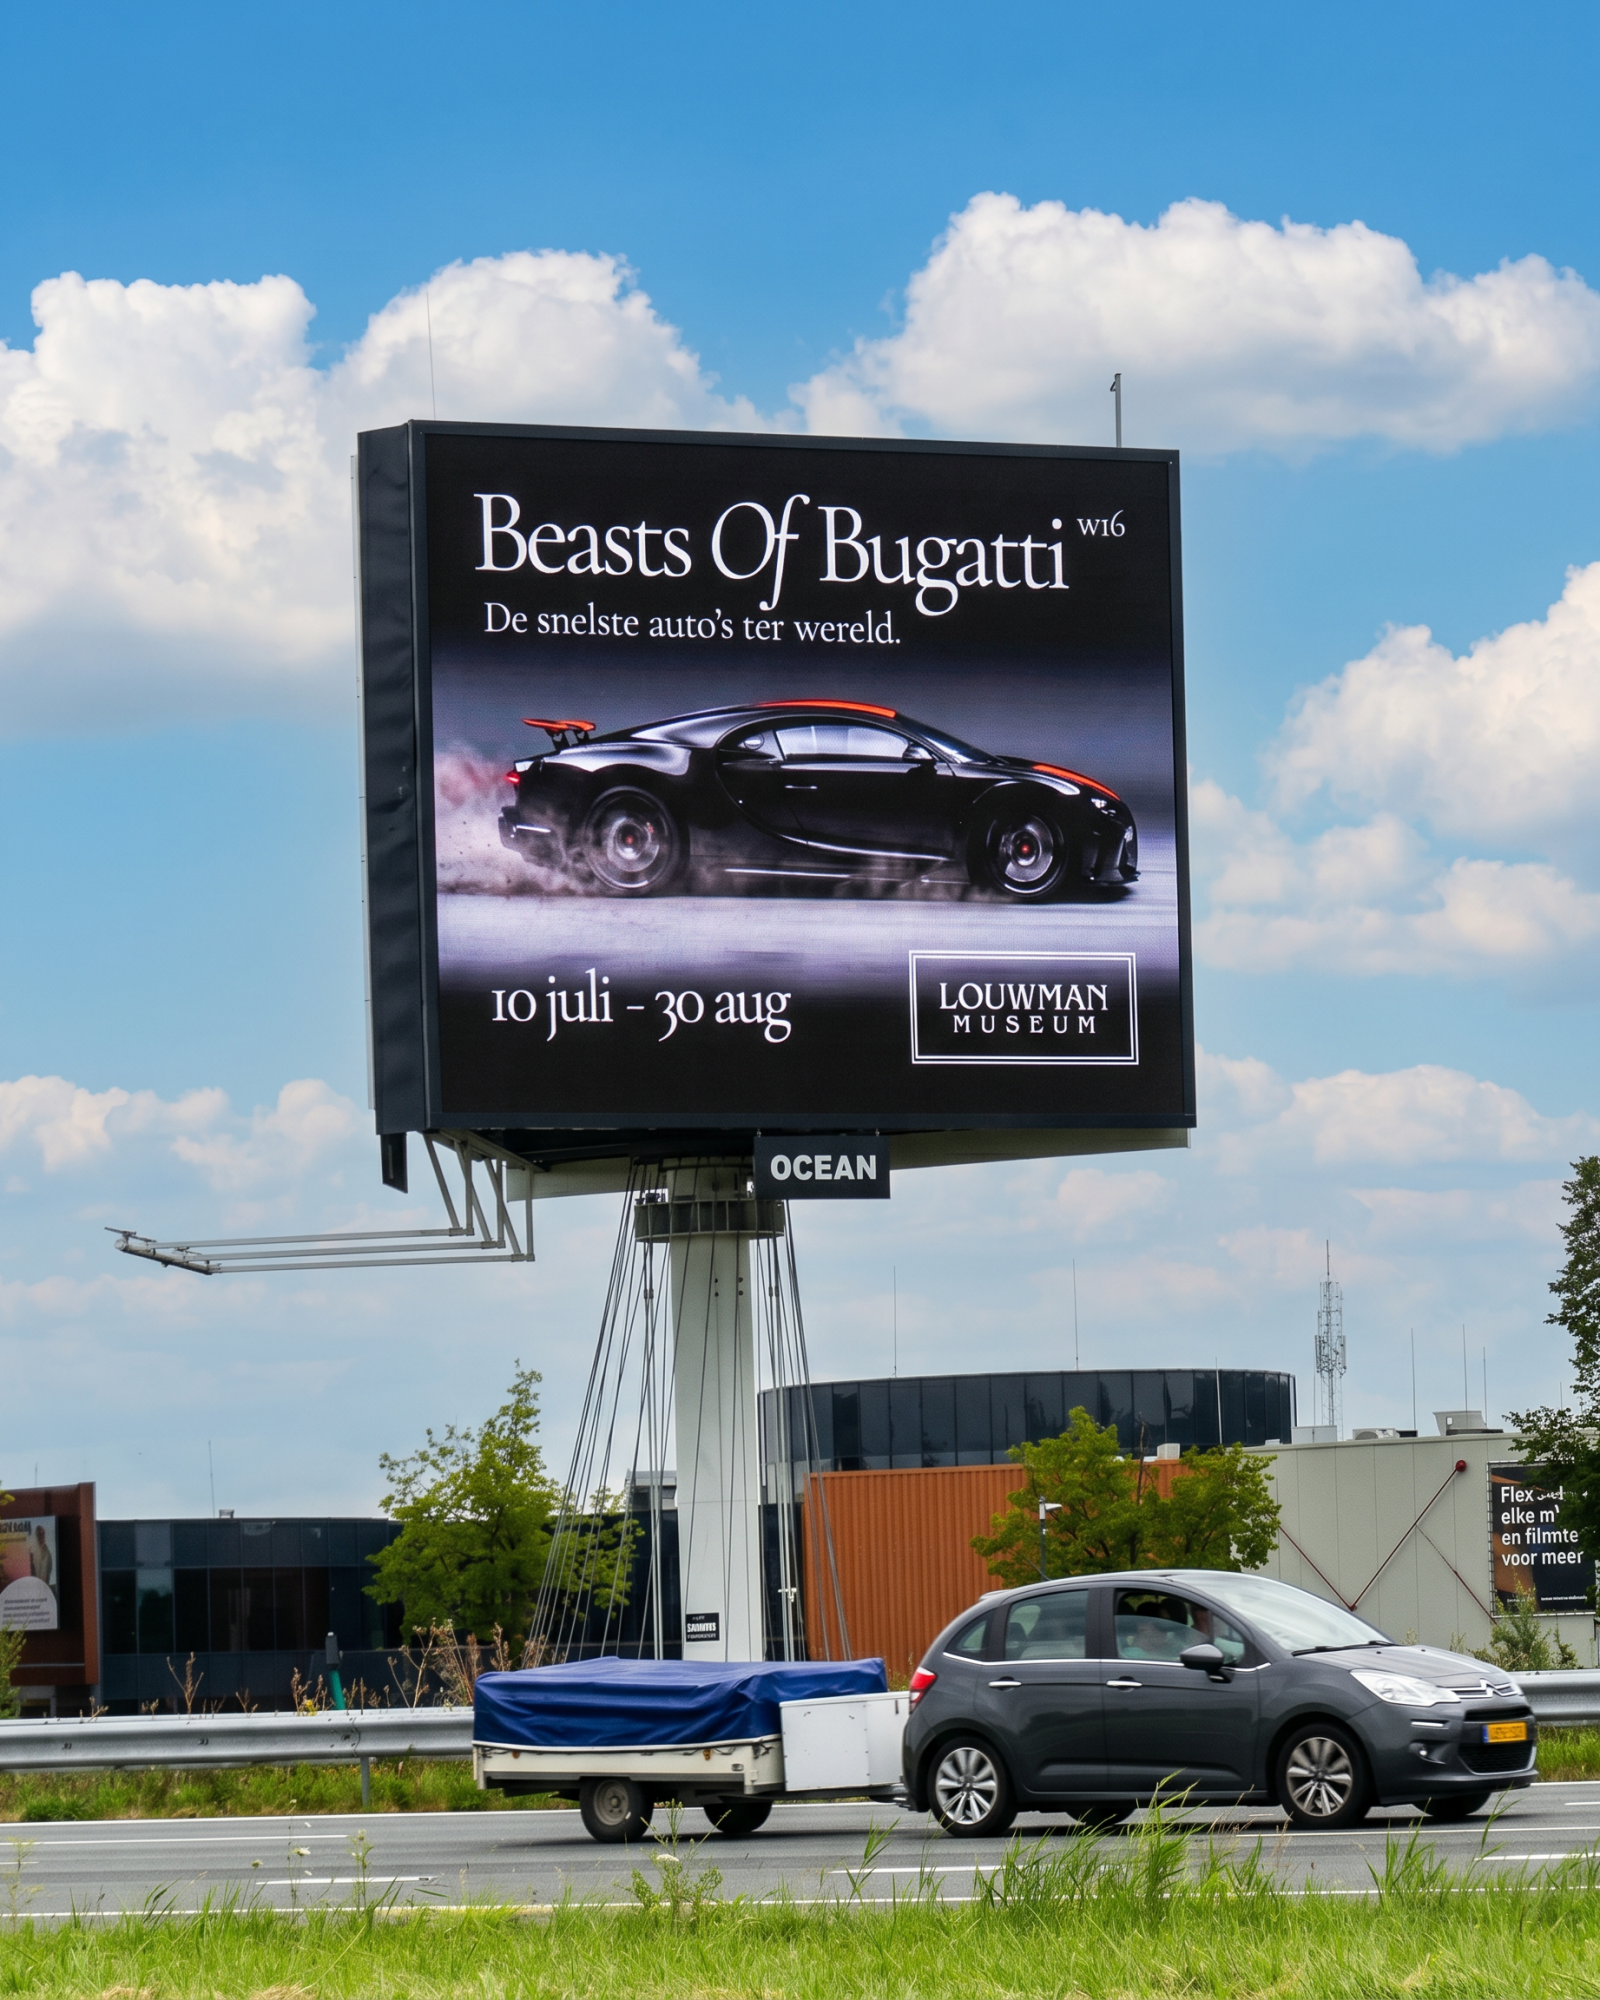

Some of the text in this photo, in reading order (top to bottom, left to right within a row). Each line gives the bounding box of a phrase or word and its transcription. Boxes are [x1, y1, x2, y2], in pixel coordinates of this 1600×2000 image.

[474, 493, 692, 578] Beasts
[711, 494, 811, 611] Of
[817, 506, 1070, 617] Bugatti
[484, 602, 528, 634] De
[537, 601, 639, 638] snelste
[743, 616, 785, 642] ter
[793, 609, 901, 646] wereld.
[492, 990, 537, 1022] 10
[546, 967, 614, 1041] juli
[655, 990, 704, 1042] 30
[715, 991, 791, 1043] aug
[939, 982, 1108, 1011] LOUWMAN
[953, 1015, 1096, 1034] MUSEUM
[770, 1154, 877, 1181] OCEAN
[1501, 1486, 1534, 1504] Flex
[1501, 1507, 1535, 1524] elke
[1501, 1532, 1521, 1546] en
[1501, 1550, 1584, 1567] voor meer
